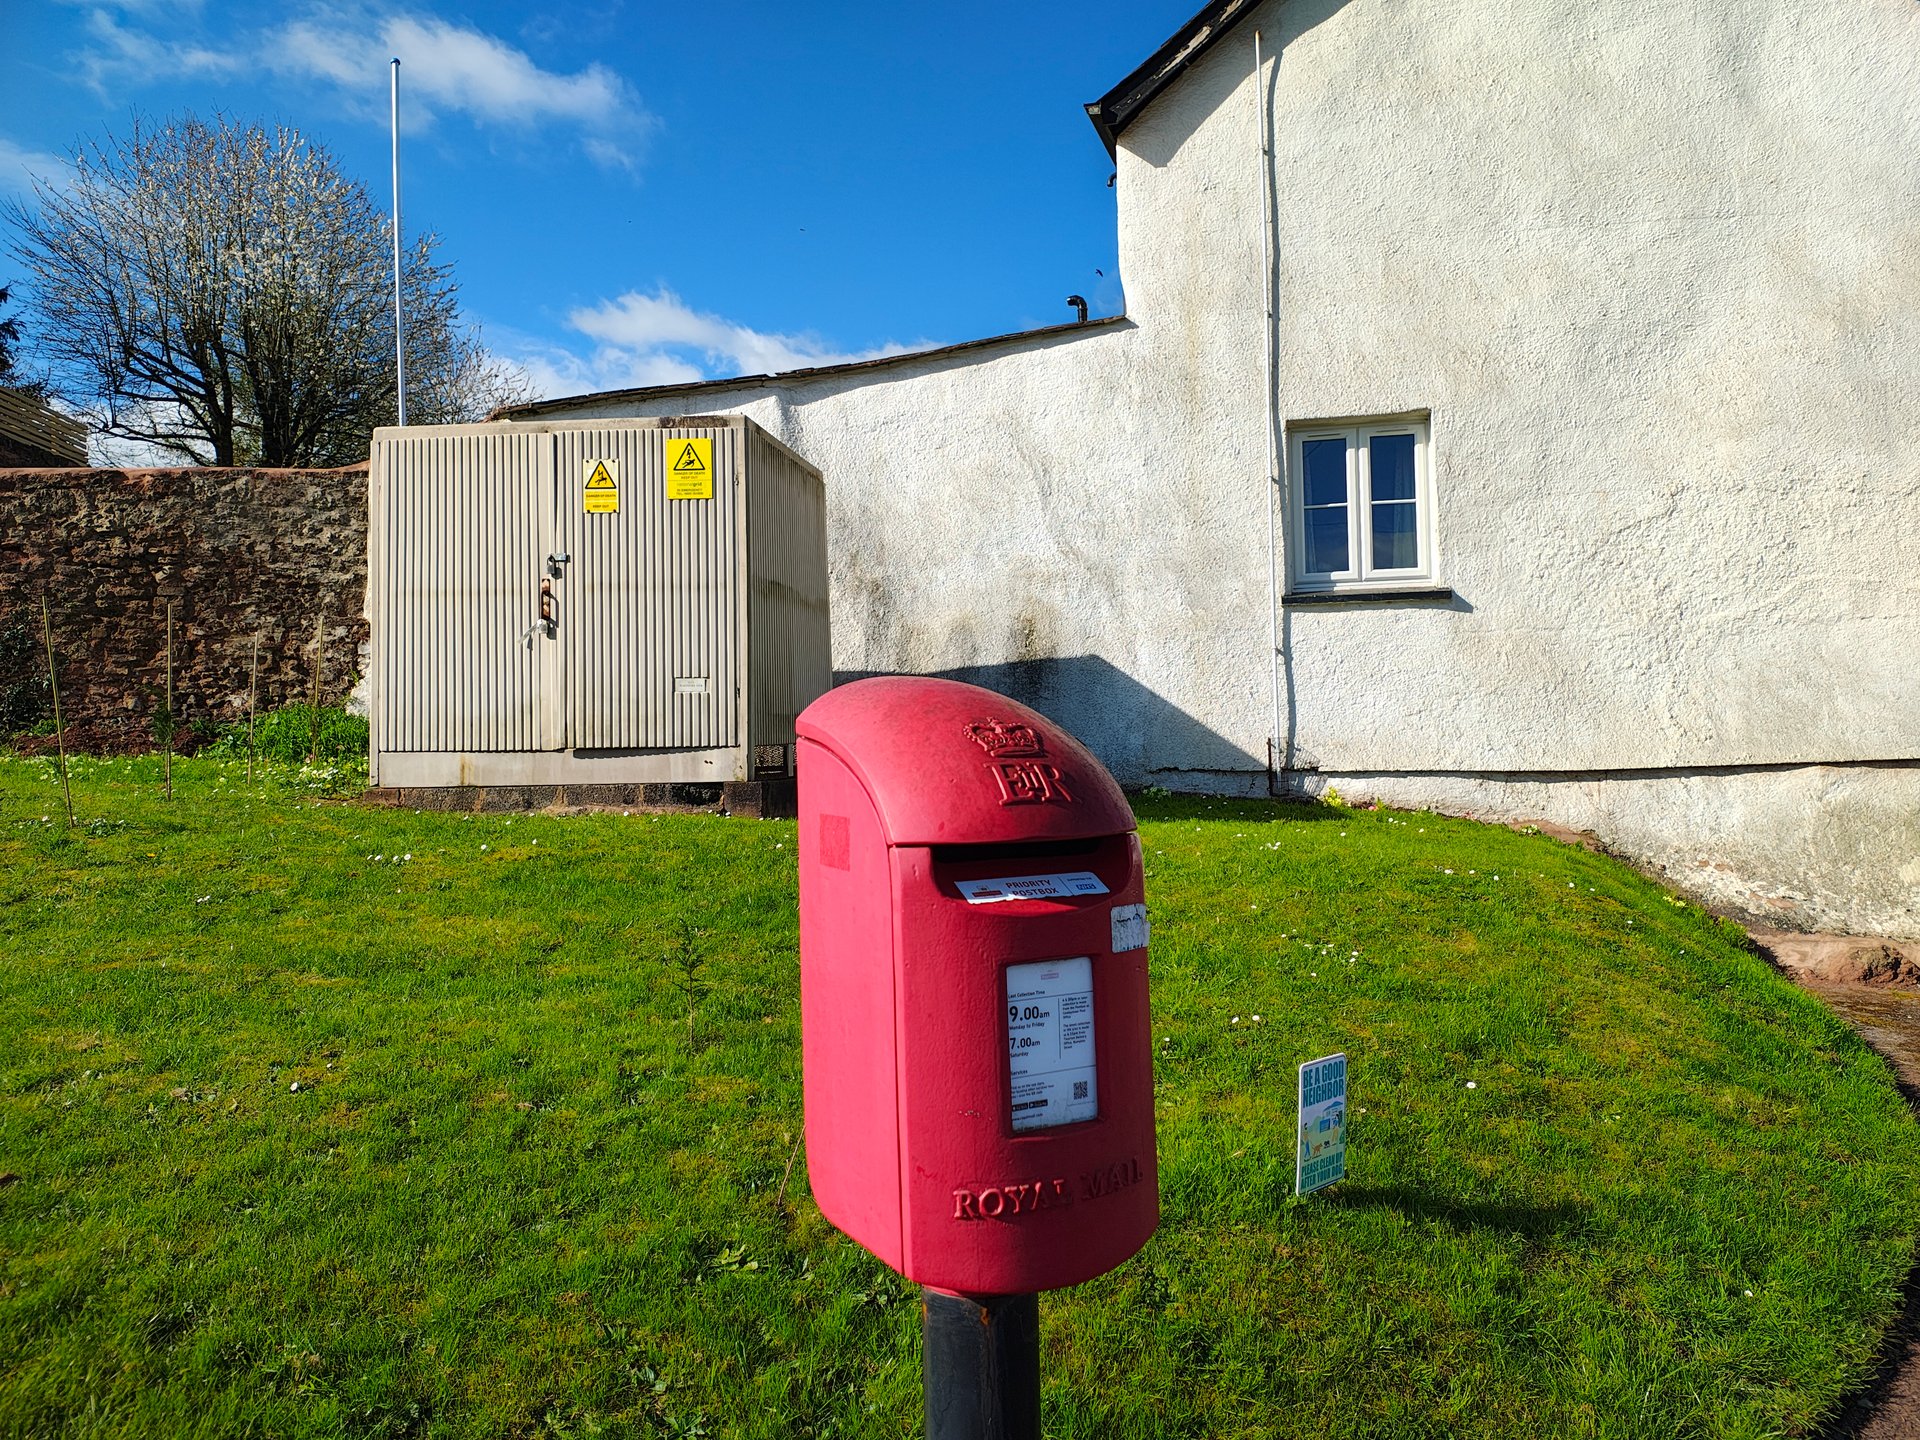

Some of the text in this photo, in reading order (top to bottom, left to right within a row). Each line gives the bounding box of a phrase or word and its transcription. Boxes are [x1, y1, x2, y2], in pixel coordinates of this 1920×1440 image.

[1005, 880, 1051, 889] PRIORITY
[1012, 888, 1059, 896] POSTBOX
[1009, 1006, 1050, 1022] 9.00am
[1010, 1037, 1040, 1050] 7.00am
[1303, 1060, 1344, 1089] BE A GOOD
[1302, 1079, 1344, 1108] NEIGHBOR
[1301, 1159, 1319, 1177] PLEASE
[1320, 1154, 1336, 1171] CLEAN
[1301, 1173, 1316, 1189] AFTER
[1331, 1163, 1343, 1178] DOG
[952, 1155, 1144, 1220] ROYAL MAIL
